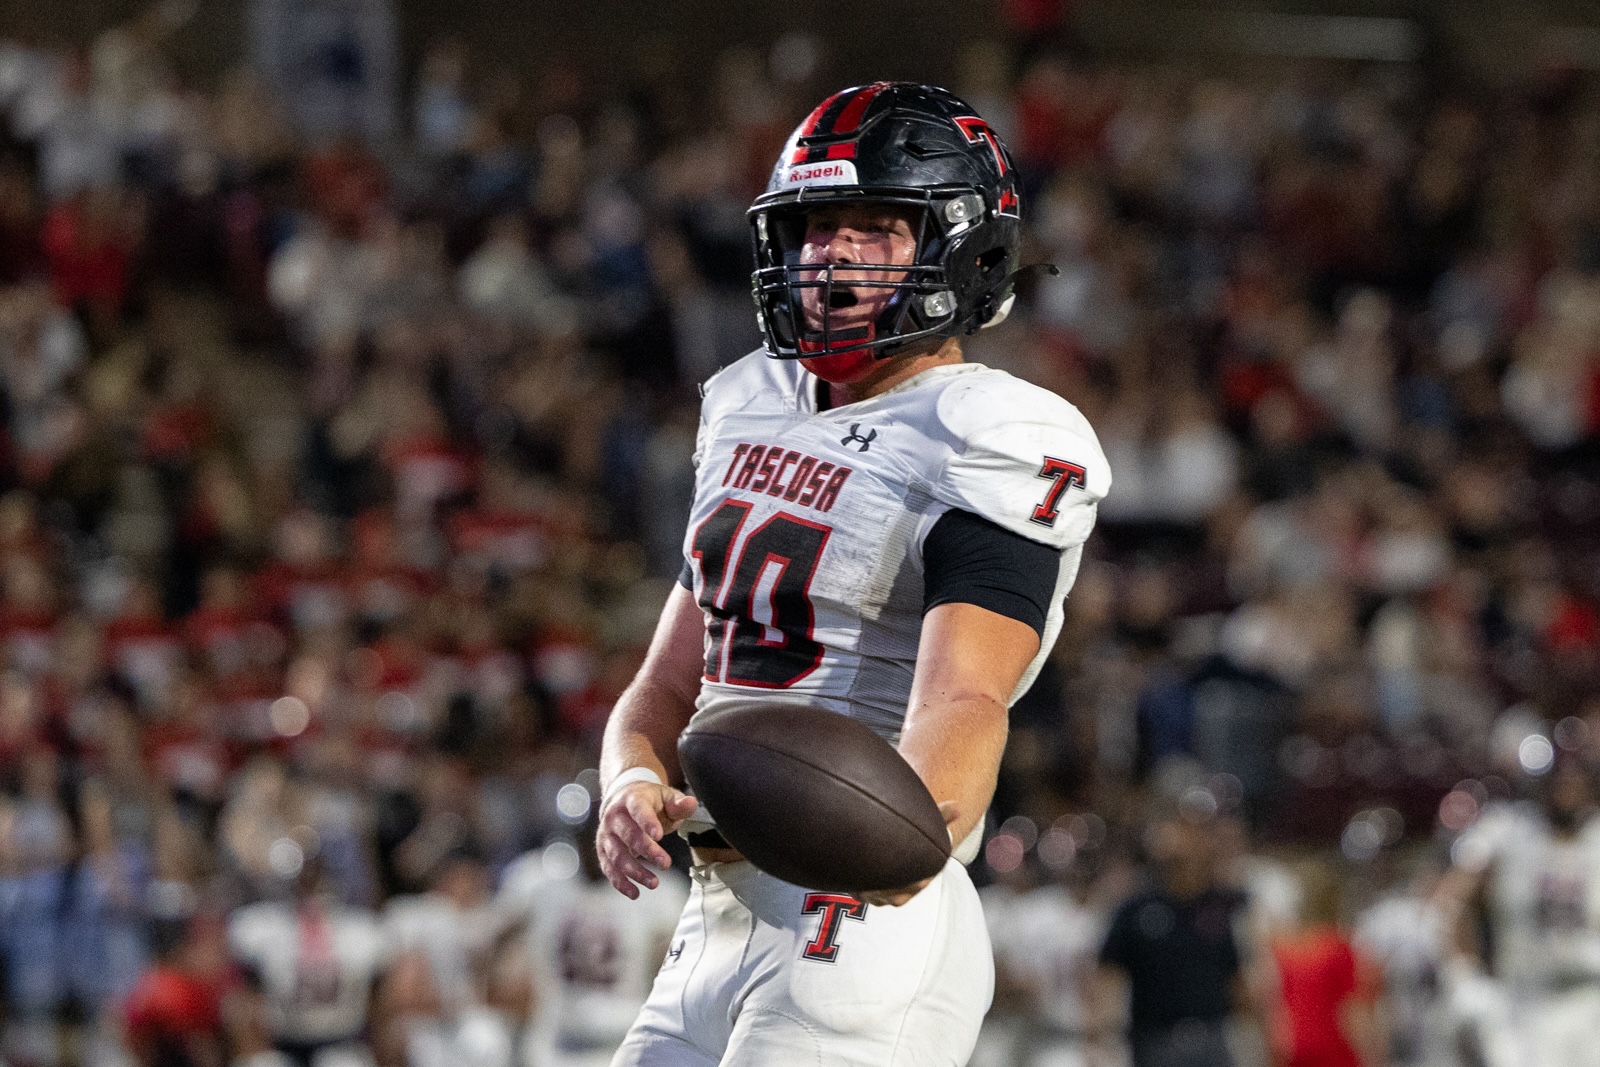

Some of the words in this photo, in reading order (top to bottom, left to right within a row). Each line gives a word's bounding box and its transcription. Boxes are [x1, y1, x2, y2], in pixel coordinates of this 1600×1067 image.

[952, 115, 1020, 220] T
[722, 443, 853, 513] TASCOSA
[1028, 455, 1087, 528] T
[691, 497, 833, 689] 10
[800, 892, 867, 964] T
